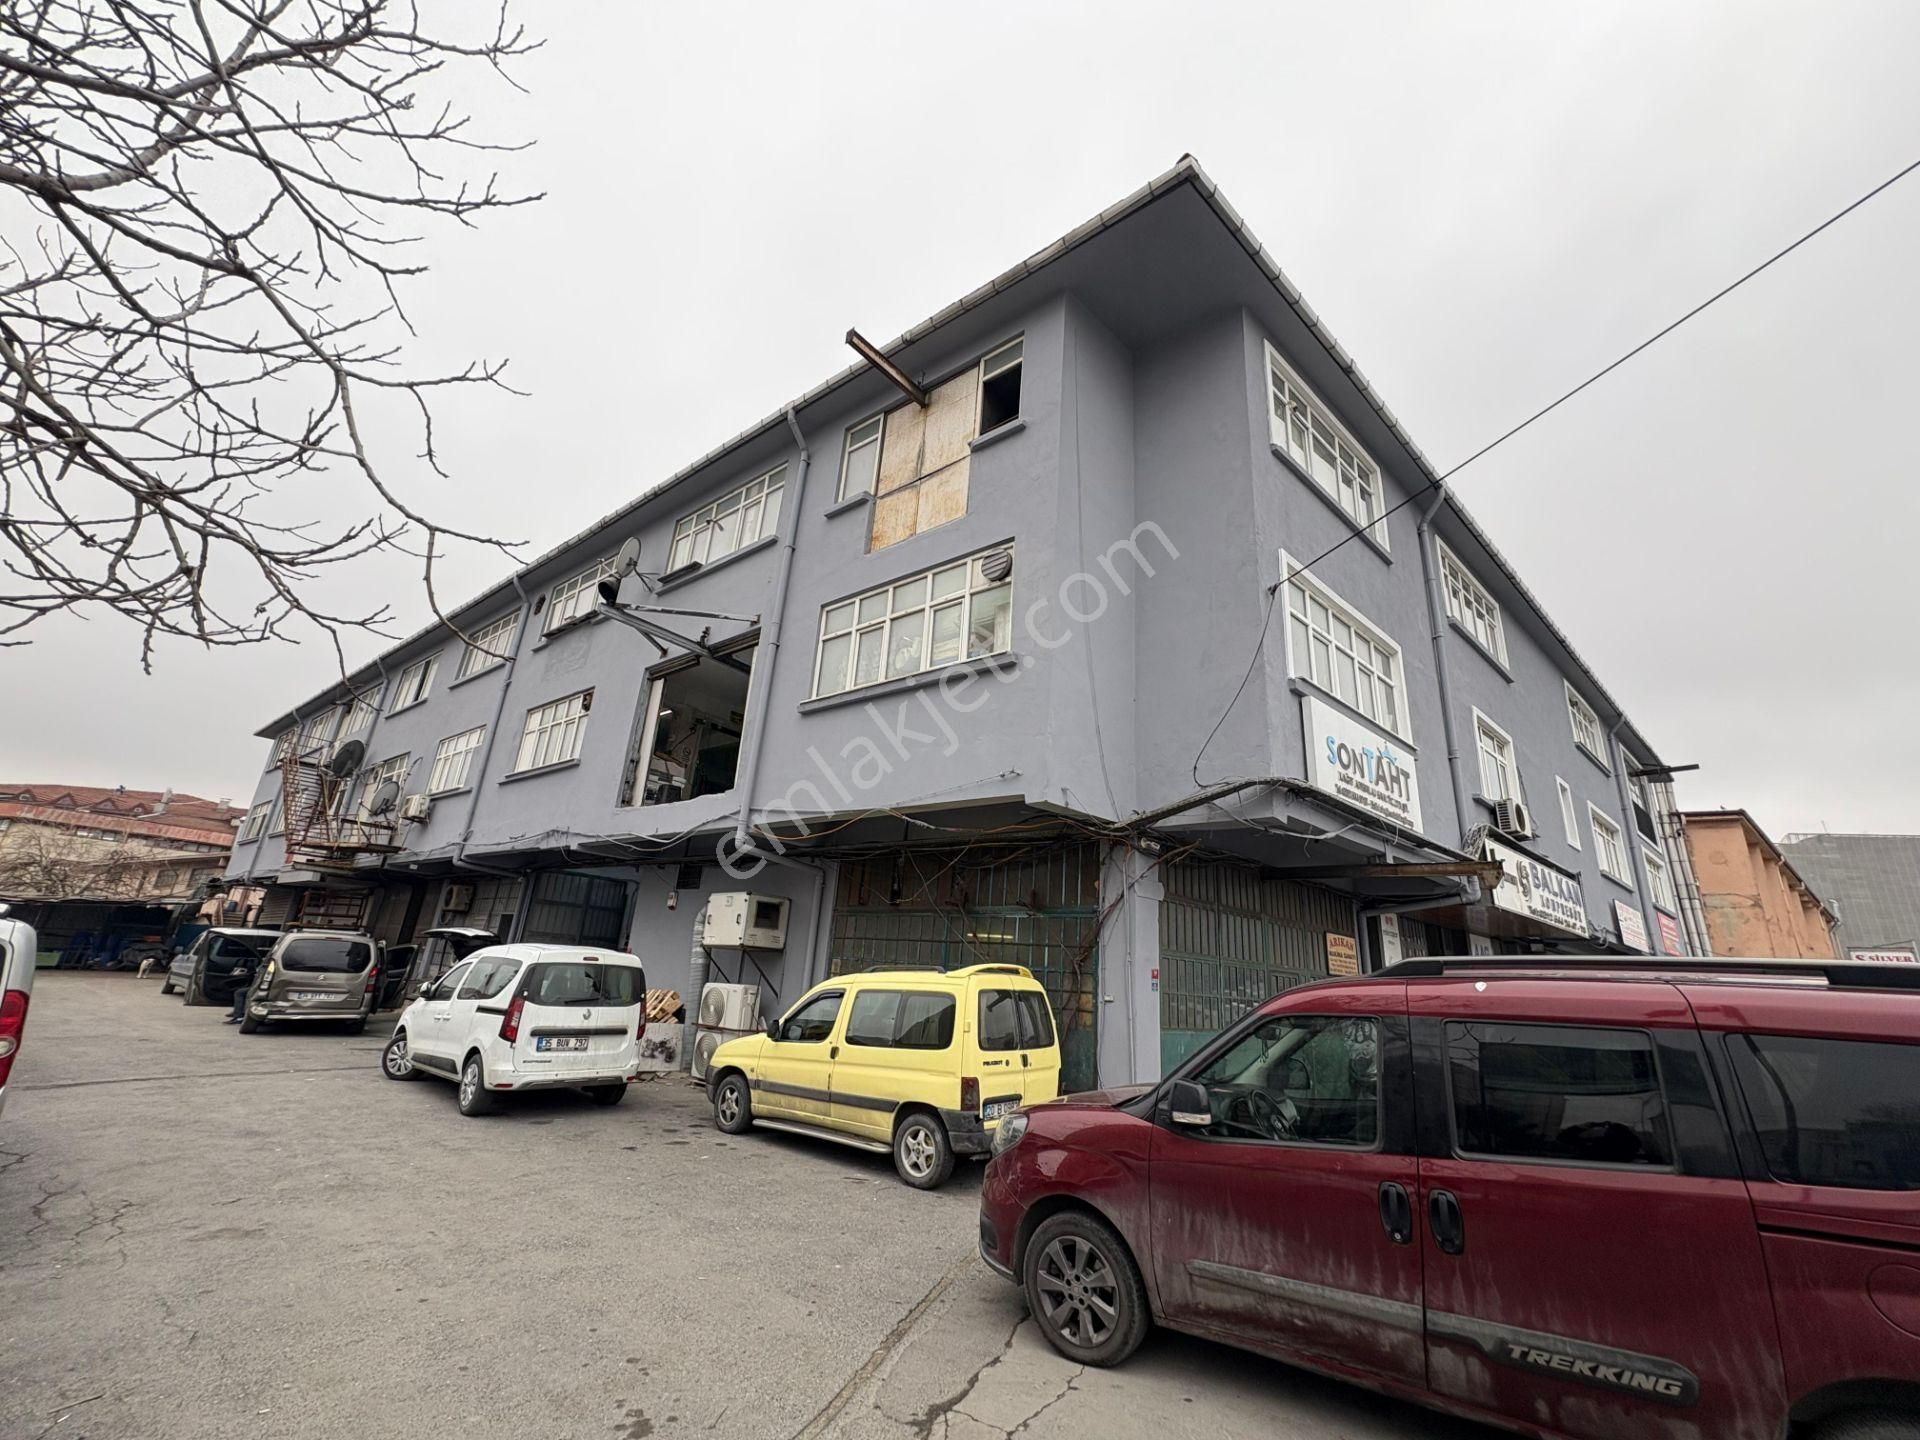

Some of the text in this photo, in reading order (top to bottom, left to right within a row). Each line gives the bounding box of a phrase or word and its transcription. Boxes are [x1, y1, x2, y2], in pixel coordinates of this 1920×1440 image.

[1326, 735, 1411, 802] SONTAHT
[1530, 862, 1583, 909] BALKAN
[574, 1038, 587, 1048] 797
[1507, 1343, 1684, 1397] TREKKING
